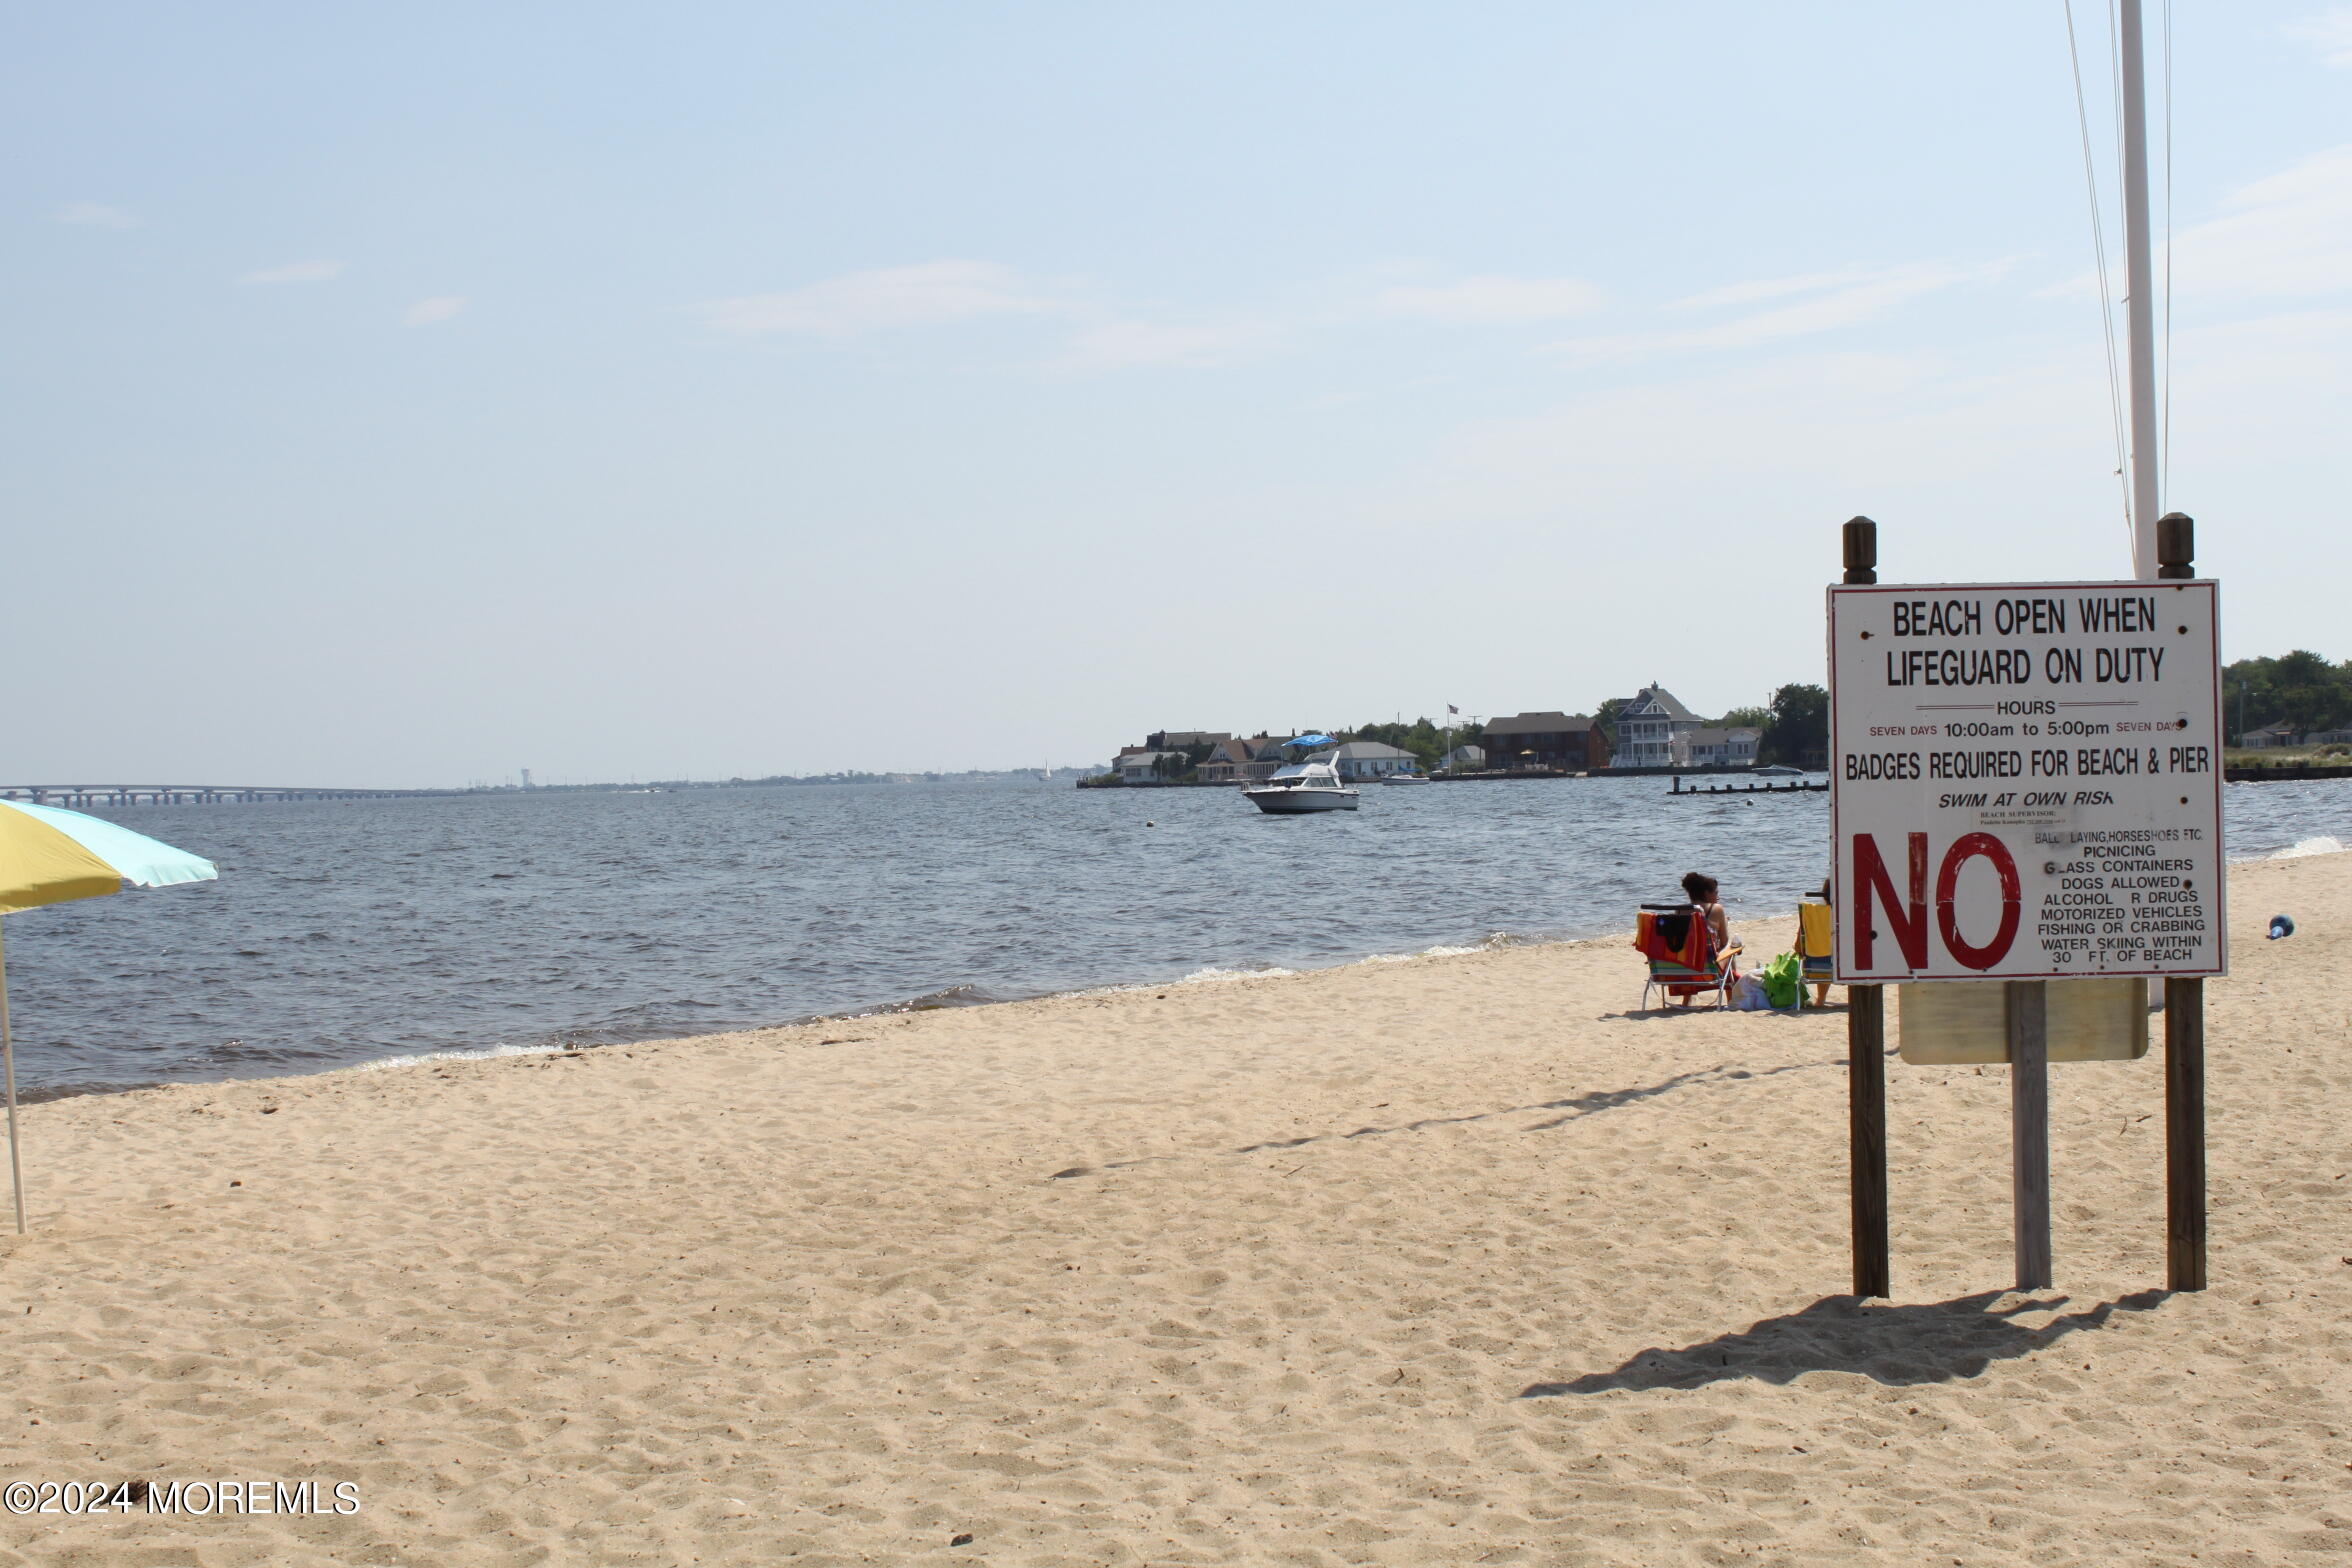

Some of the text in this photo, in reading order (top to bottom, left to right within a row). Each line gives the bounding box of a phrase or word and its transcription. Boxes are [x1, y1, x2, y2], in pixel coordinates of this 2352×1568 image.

[1893, 597, 2155, 637] BEACH OPEN WHEN
[1887, 647, 2164, 686] LIFEGUARD ON DUTY
[1997, 701, 2056, 715] HOURS
[1870, 726, 1906, 736] SEVEN
[1910, 725, 1937, 735] DAYS
[1944, 723, 2014, 737] 10:00am
[2023, 722, 2039, 736] to
[2047, 721, 2109, 738] 5:00pm
[2116, 722, 2152, 731] SEVEN
[1846, 746, 2209, 780] BADGES REQUIRED FOR BEACH & PIER
[1939, 790, 2113, 808] SWIM AT OWN RISK
[2084, 845, 2155, 858] PICNICING
[2044, 859, 2193, 875] GASS CONTAINERS
[2062, 877, 2179, 890] DOGS ALLOWED
[1853, 831, 2022, 971] NO
[2044, 893, 2113, 905] ALCOHOL
[2148, 891, 2198, 903] DRUGS
[2041, 906, 2202, 921] MOTORIZED VEHICLES
[2038, 920, 2205, 935] FISHING OR CRABBING
[2042, 936, 2202, 950] WATER SKIING WITHIN
[2053, 949, 2192, 963] 30 FT. OF BEACH
